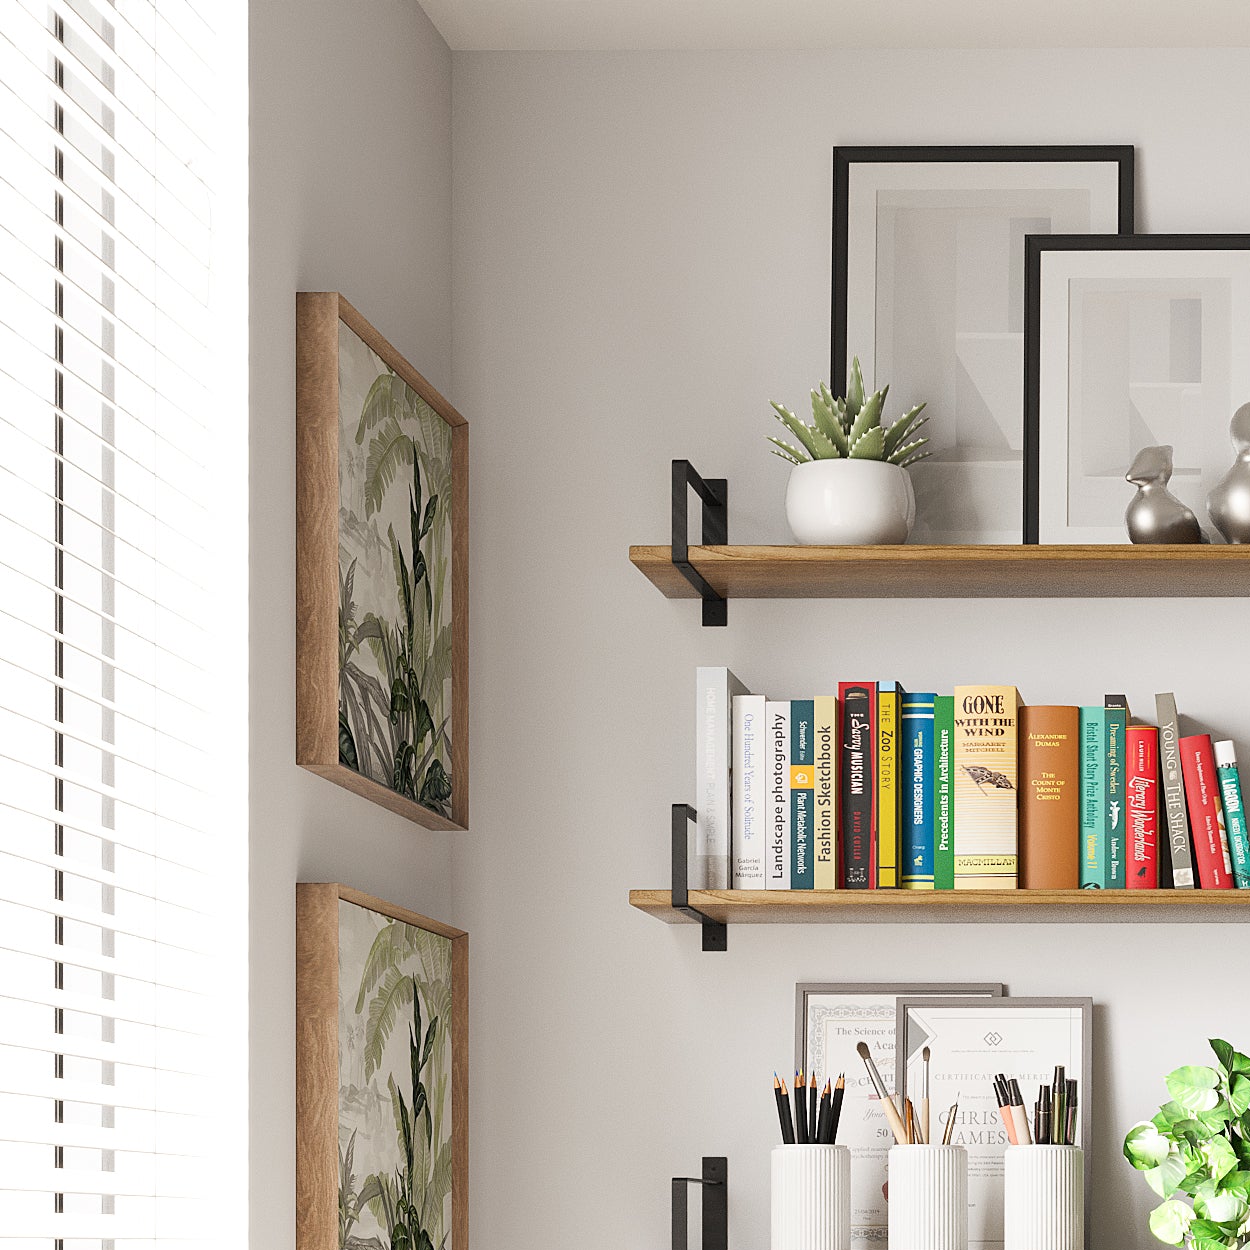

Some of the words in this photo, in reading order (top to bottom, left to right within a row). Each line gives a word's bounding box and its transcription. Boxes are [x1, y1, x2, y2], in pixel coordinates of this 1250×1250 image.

[962, 695, 1004, 715] GONE
[744, 713, 755, 731] One
[844, 718, 870, 750] Savvy
[955, 718, 989, 728] WITH
[989, 718, 1015, 728] THE
[963, 728, 1005, 736] WIND
[1086, 722, 1099, 743] Bristol
[744, 733, 755, 769] Hundred
[1086, 744, 1099, 762] Short
[1108, 723, 1120, 757] Dreaming
[1162, 721, 1177, 769] YOUNG
[771, 714, 786, 803] photography
[817, 725, 831, 806] Sketchbook
[913, 748, 923, 782] GRAPHIC
[939, 729, 949, 783] Architecture
[1110, 758, 1120, 766] of
[744, 770, 755, 792] Years
[850, 751, 863, 794] MUSICIAN
[1084, 763, 1099, 780] Story
[1109, 766, 1120, 794] Sweden
[744, 793, 755, 803] of
[797, 792, 808, 811] Plant
[939, 784, 949, 794] in
[1086, 781, 1099, 797] Prize
[1128, 776, 1155, 808] Literary
[1166, 782, 1182, 809] THE
[1222, 778, 1241, 813] LAGOON
[913, 783, 923, 824] DESIGNERS
[1084, 799, 1099, 828] Anthology
[744, 806, 755, 840] Solitude
[797, 812, 808, 842] Metabolic
[817, 810, 831, 862] Fashion
[939, 795, 949, 851] Precedents
[1128, 809, 1155, 861] Wonderlands
[1169, 812, 1186, 853] SHACK
[772, 807, 784, 879] Landscape
[1110, 836, 1119, 859] Andrew
[797, 843, 808, 874] Networks
[958, 859, 1015, 867] MACMILLAN
[1110, 861, 1119, 879] Brown
[835, 1027, 852, 1036] The
[854, 1027, 885, 1036] Science
[1018, 1073, 1050, 1081] MERIT
[876, 1129, 888, 1138] 50
